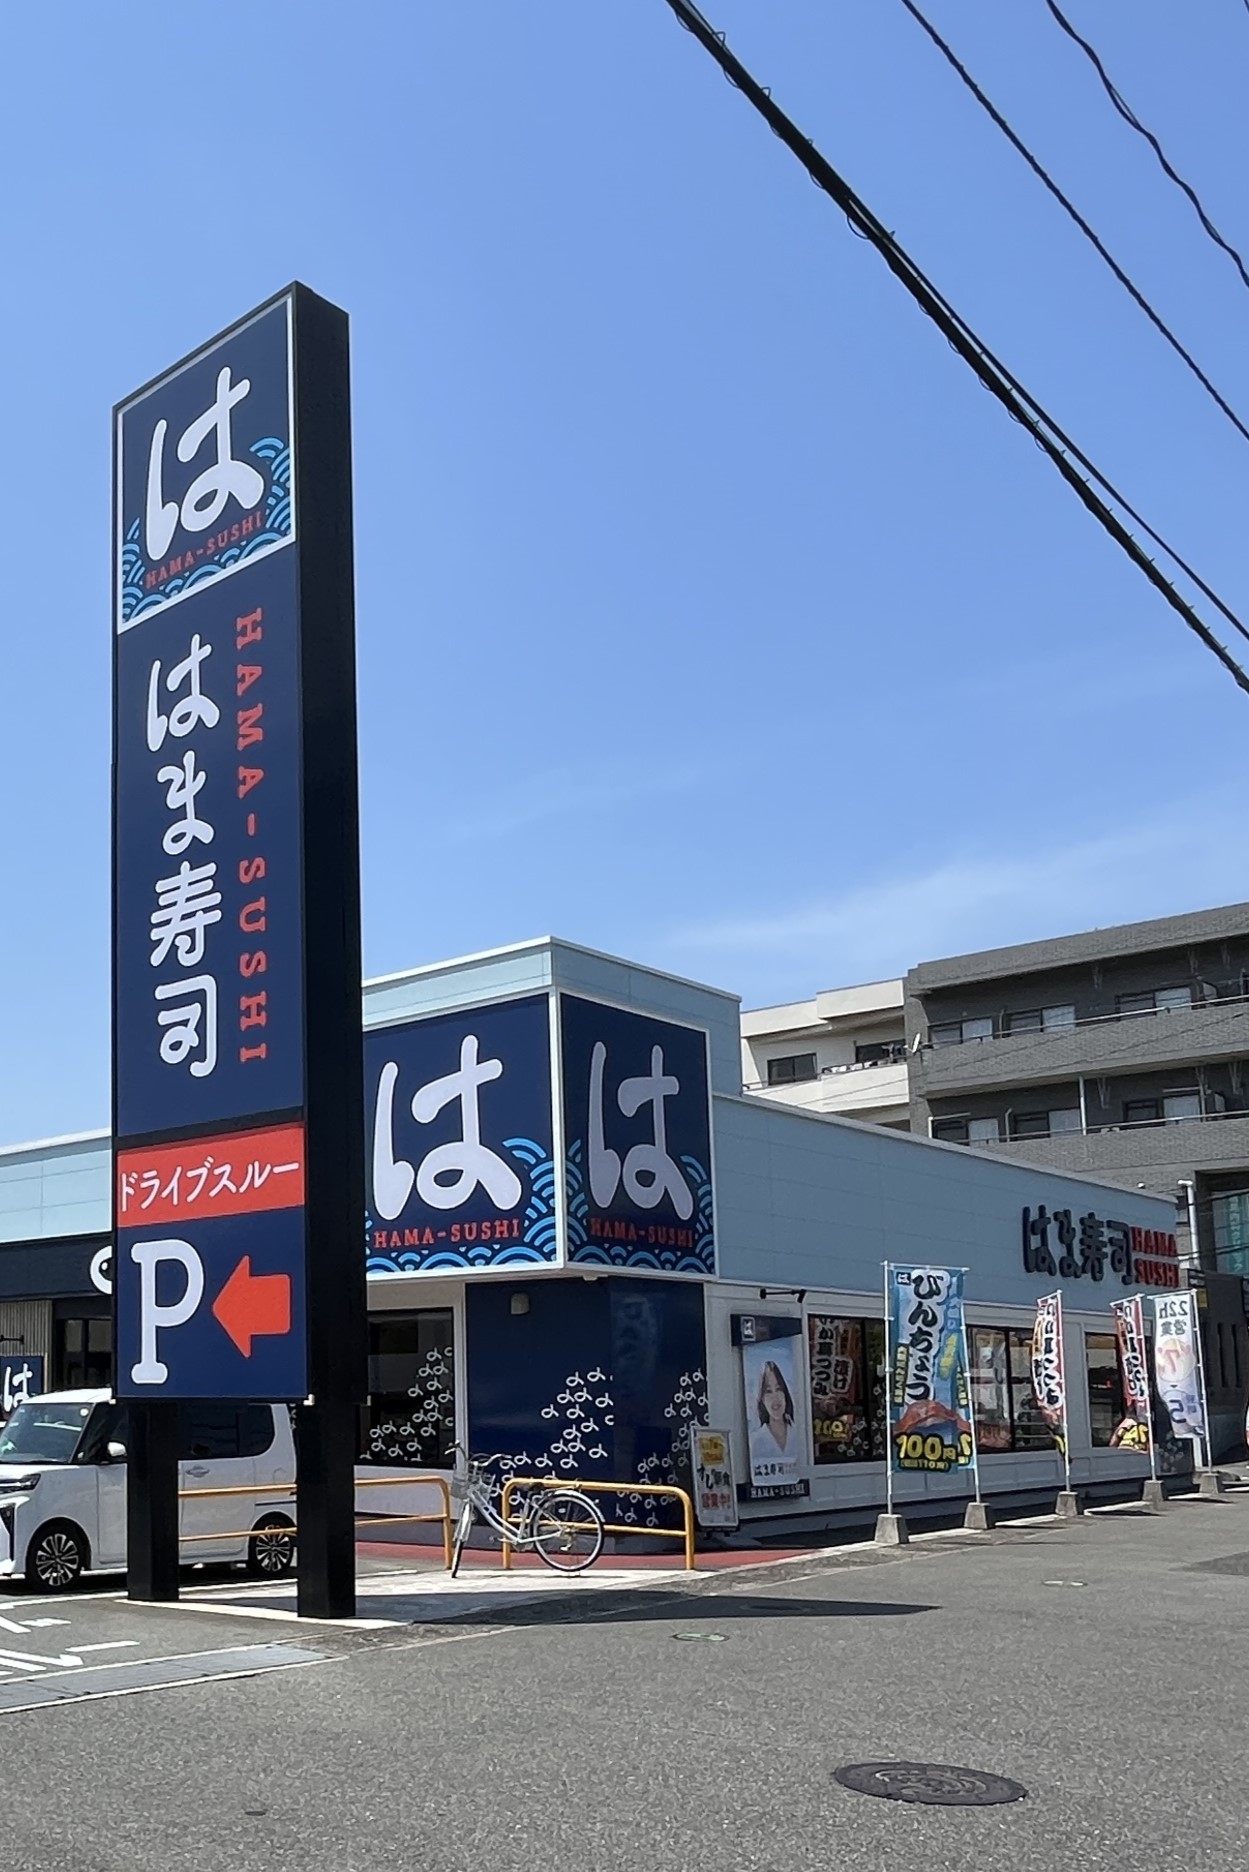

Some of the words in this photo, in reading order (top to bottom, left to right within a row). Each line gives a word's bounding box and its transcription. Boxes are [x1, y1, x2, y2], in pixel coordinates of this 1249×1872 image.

[147, 366, 265, 561] は
[146, 510, 264, 589] HAMA-SUSHI
[146, 633, 222, 1078] はま寿司
[236, 607, 268, 1064] HAMA-SUSHI
[373, 1034, 522, 1220] は
[588, 1041, 694, 1221] は
[120, 1155, 300, 1213] ドライブスルー
[374, 1218, 520, 1249] HAMA-SUSHI
[590, 1216, 694, 1248] HAMA-SUSHI
[1021, 1204, 1134, 1286] はま寿司
[1130, 1226, 1178, 1258] HAMA
[1134, 1257, 1180, 1288] SUSHI
[131, 1239, 204, 1384] P
